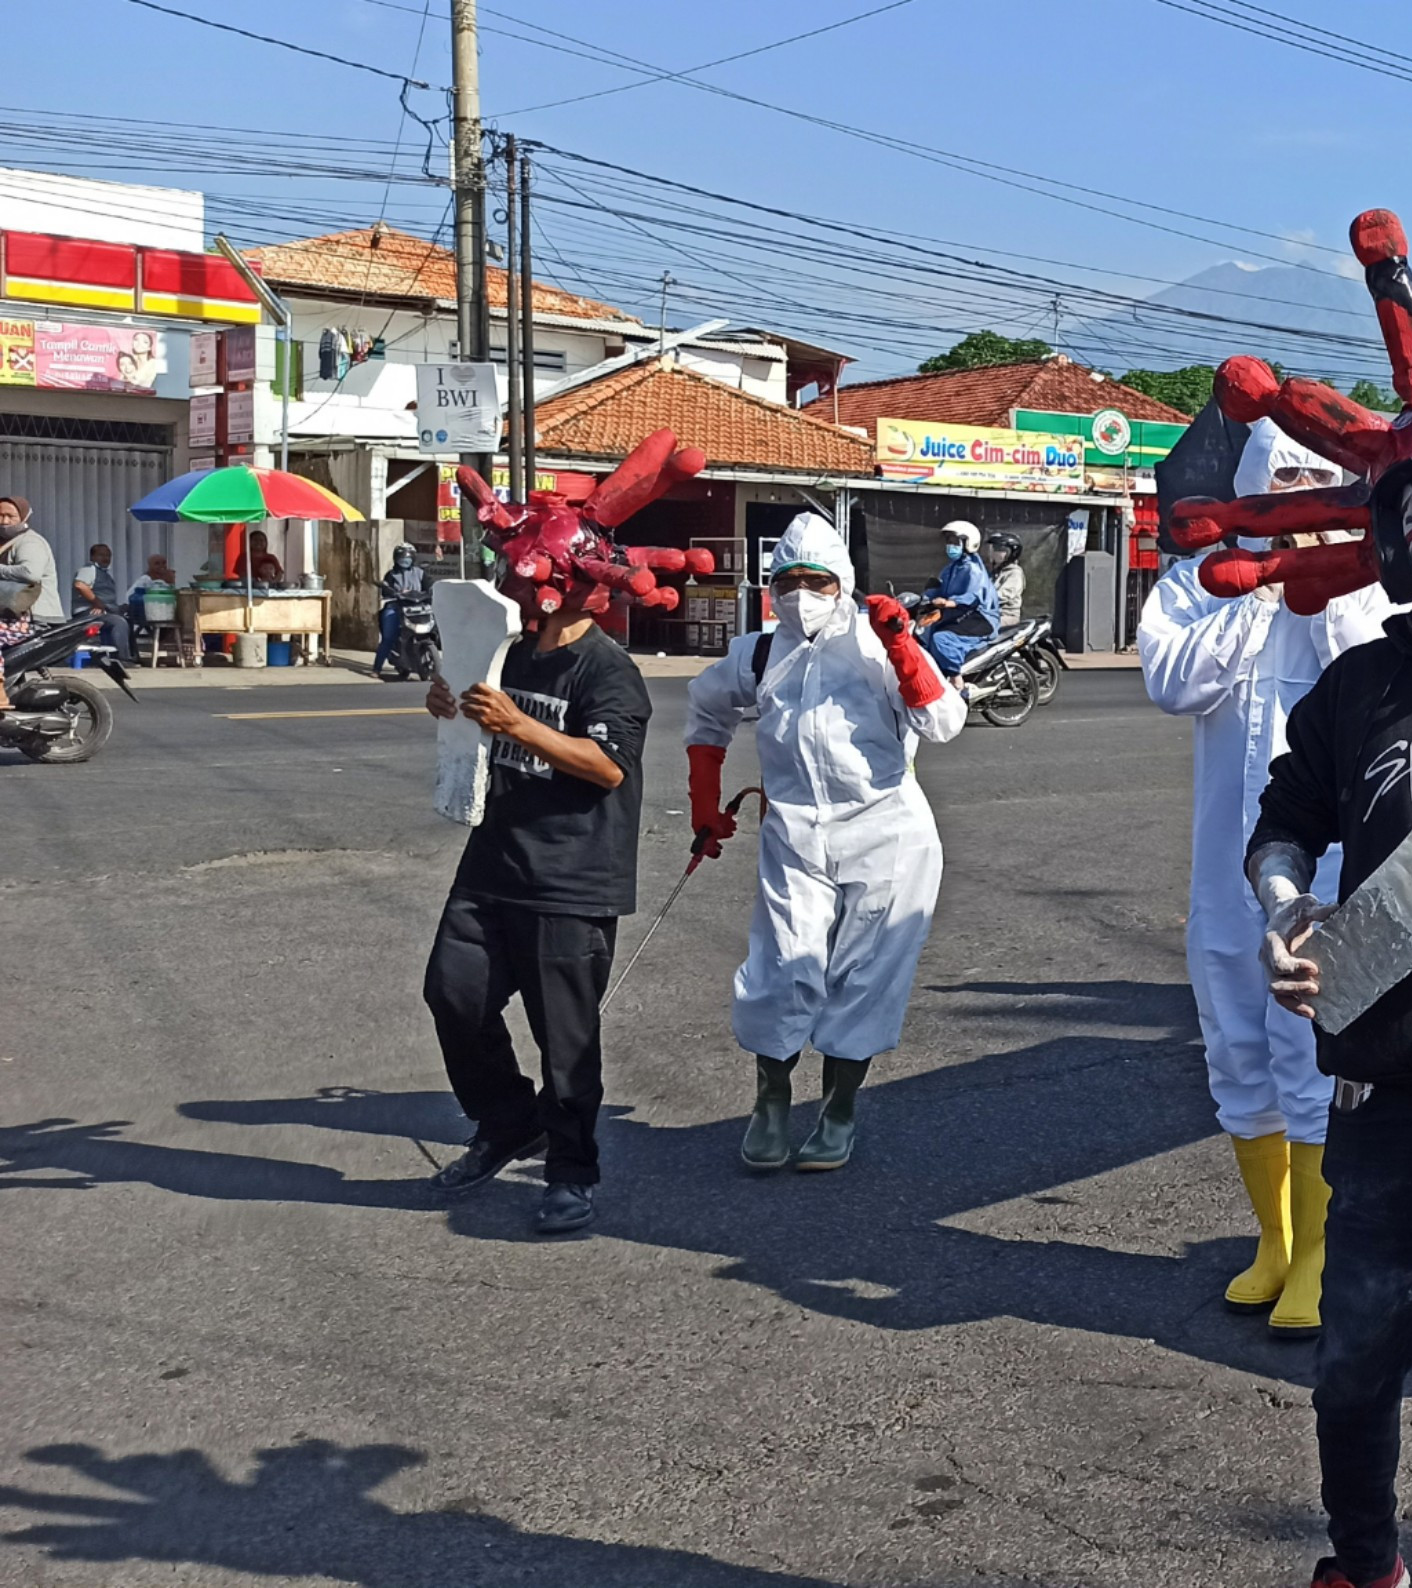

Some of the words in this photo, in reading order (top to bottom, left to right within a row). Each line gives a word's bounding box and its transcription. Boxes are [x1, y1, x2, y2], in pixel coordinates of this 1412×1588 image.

[40, 339, 78, 353] Tampil
[53, 352, 105, 363] Menawan
[437, 368, 444, 385] I
[436, 390, 478, 407] BWI
[920, 436, 965, 460] Juice
[970, 439, 1041, 465] Cim-cim
[1044, 446, 1077, 468] Duo
